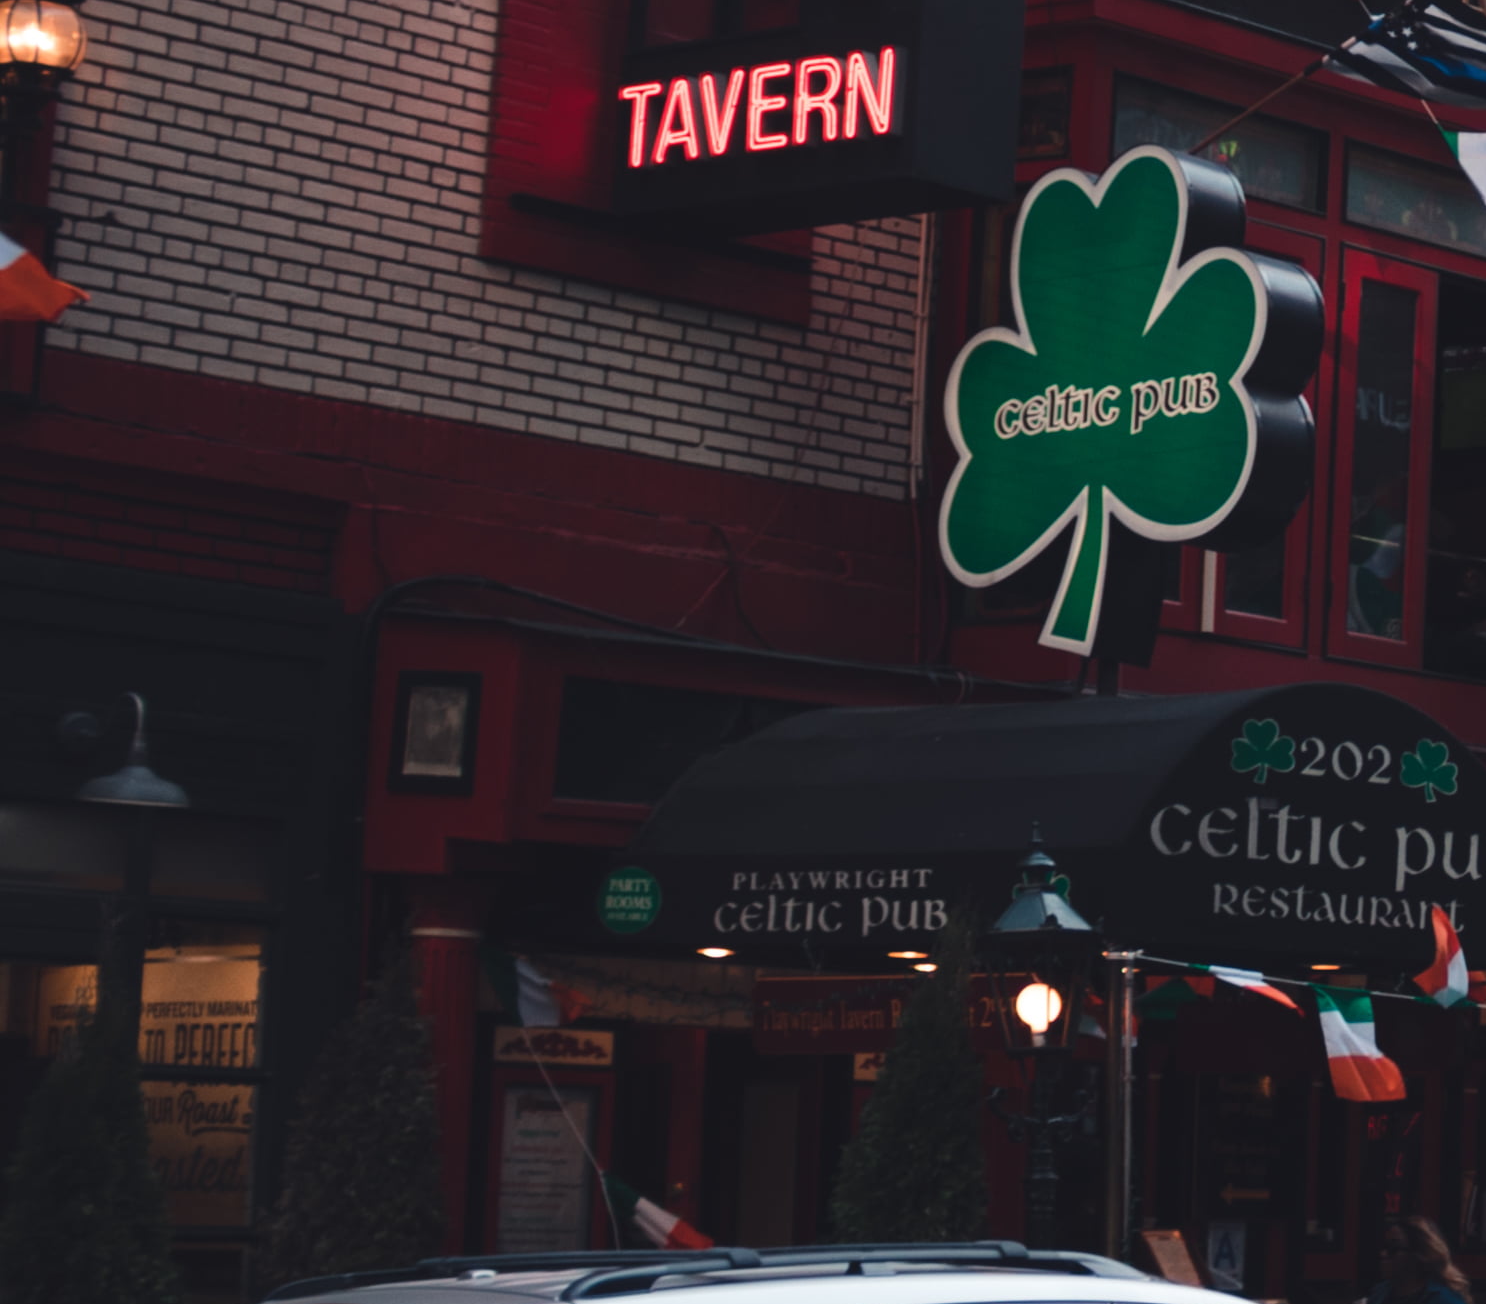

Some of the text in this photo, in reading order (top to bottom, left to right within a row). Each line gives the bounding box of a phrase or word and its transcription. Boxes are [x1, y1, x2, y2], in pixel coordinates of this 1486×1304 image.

[618, 45, 898, 169] TAVERN
[1300, 736, 1394, 785] 202
[732, 867, 934, 892] PLAYWRIGHT
[146, 1001, 205, 1019] PERFECTLY
